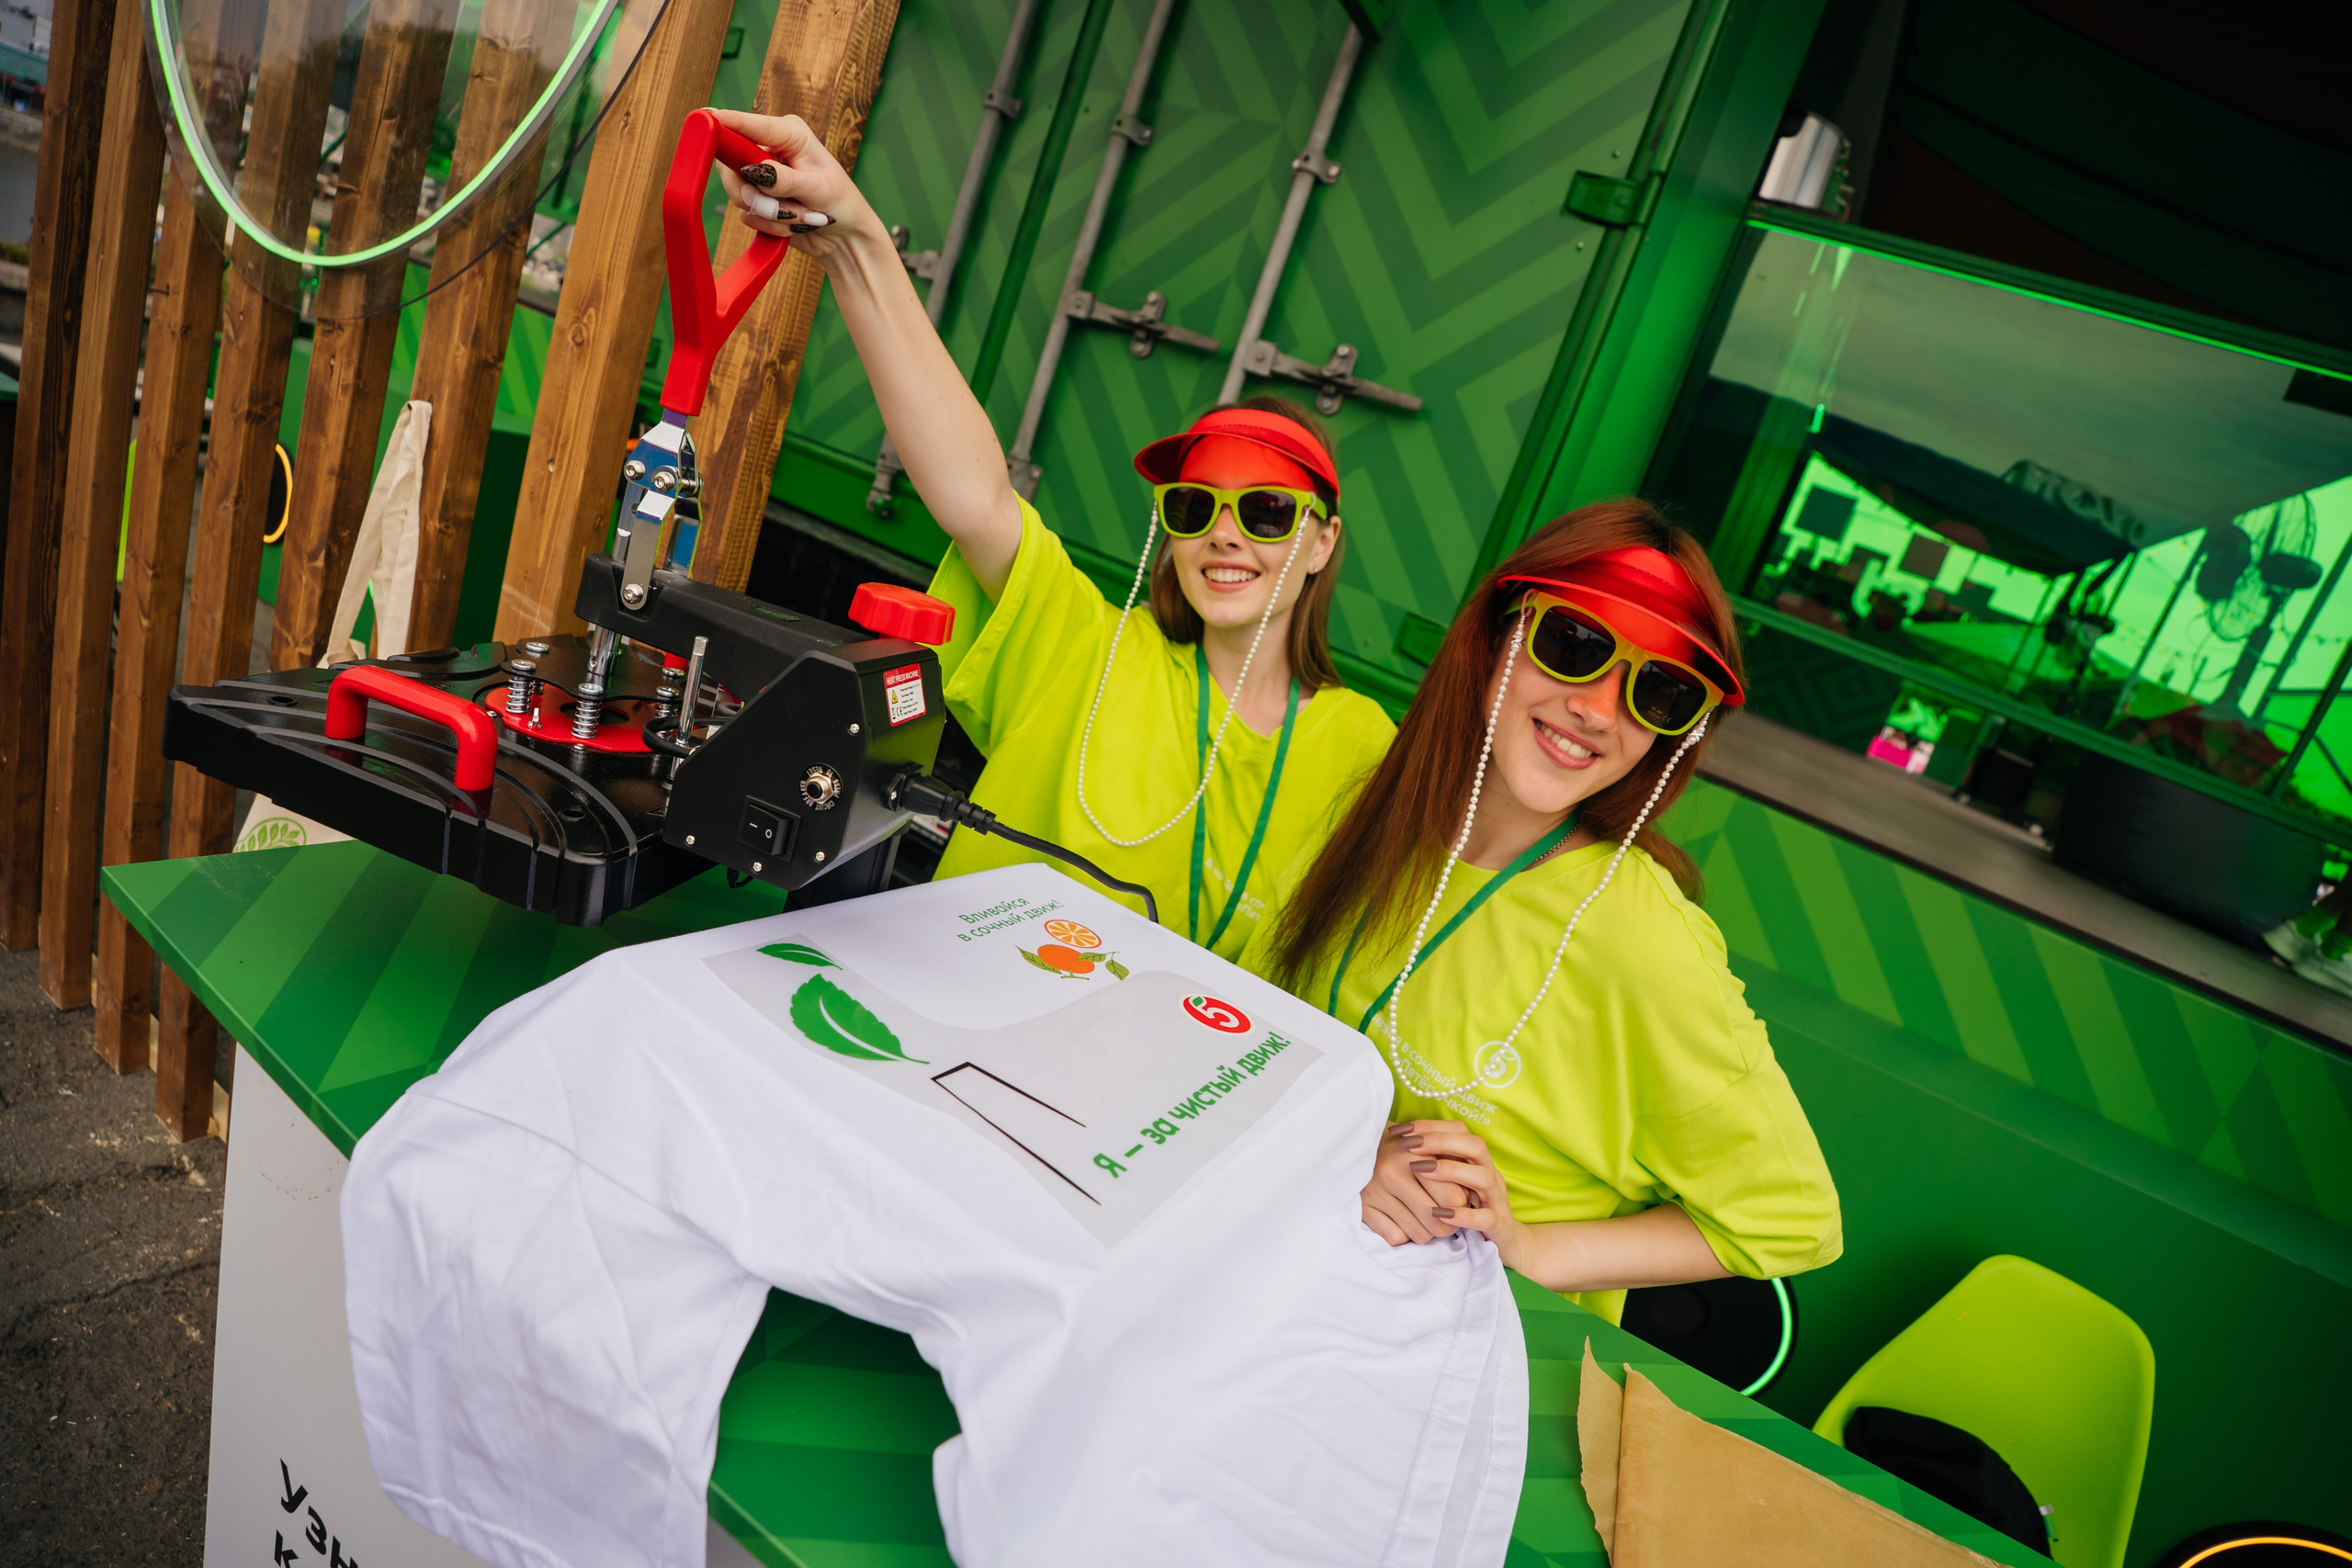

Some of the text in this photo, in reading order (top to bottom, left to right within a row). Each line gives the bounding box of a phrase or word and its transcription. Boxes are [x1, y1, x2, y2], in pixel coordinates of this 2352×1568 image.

[956, 899, 1065, 942] в сочный движ!
[958, 897, 1030, 924] Вливайся
[1409, 1050, 1457, 1090] сочный
[1092, 1153, 1128, 1179] Я
[1140, 1118, 1181, 1145] за
[1167, 1065, 1248, 1120] чистый
[1236, 1032, 1292, 1077] движ!
